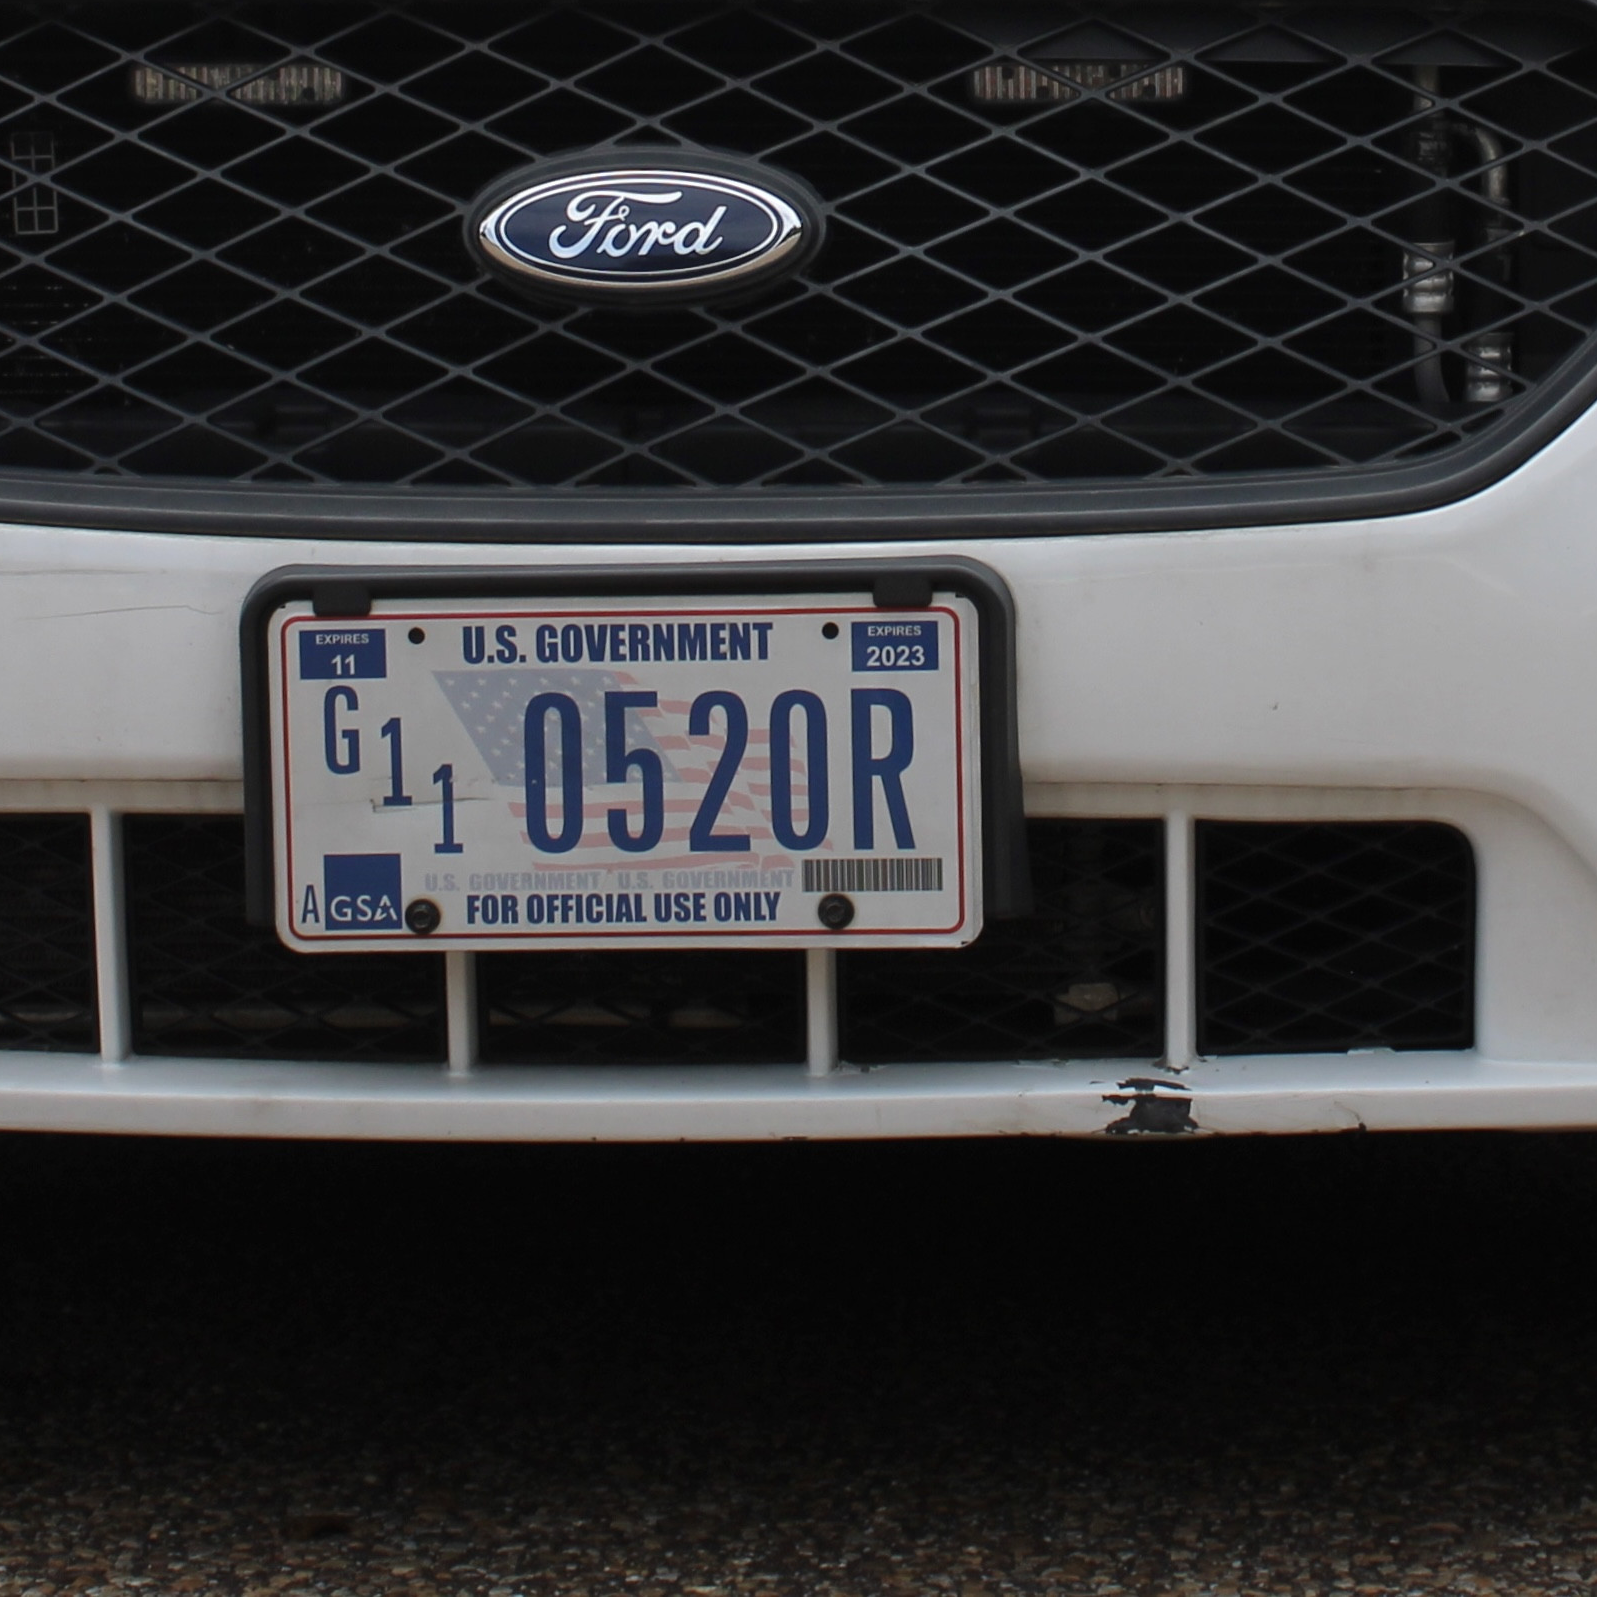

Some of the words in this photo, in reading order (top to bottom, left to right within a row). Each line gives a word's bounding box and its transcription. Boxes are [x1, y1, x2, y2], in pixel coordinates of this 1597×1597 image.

[548, 189, 727, 259] Ford
[315, 633, 370, 645] EXPIRES
[462, 625, 527, 664] U.S.
[535, 622, 773, 663] GOVERNMENT
[867, 625, 922, 638] EXPIRES
[331, 654, 356, 676] 11
[866, 645, 926, 667] 2023
[523, 688, 917, 854] 0520R
[425, 873, 460, 892] U.S.
[469, 870, 601, 891] GOVERNMENT
[618, 870, 653, 890] U.S.
[663, 869, 795, 889] GOVERNMENT
[301, 884, 320, 924] A
[330, 895, 398, 921] GSA
[467, 895, 519, 924] FOR
[526, 893, 647, 924] OFFICIAL
[654, 892, 707, 923] USE
[714, 891, 781, 922] ONLY
